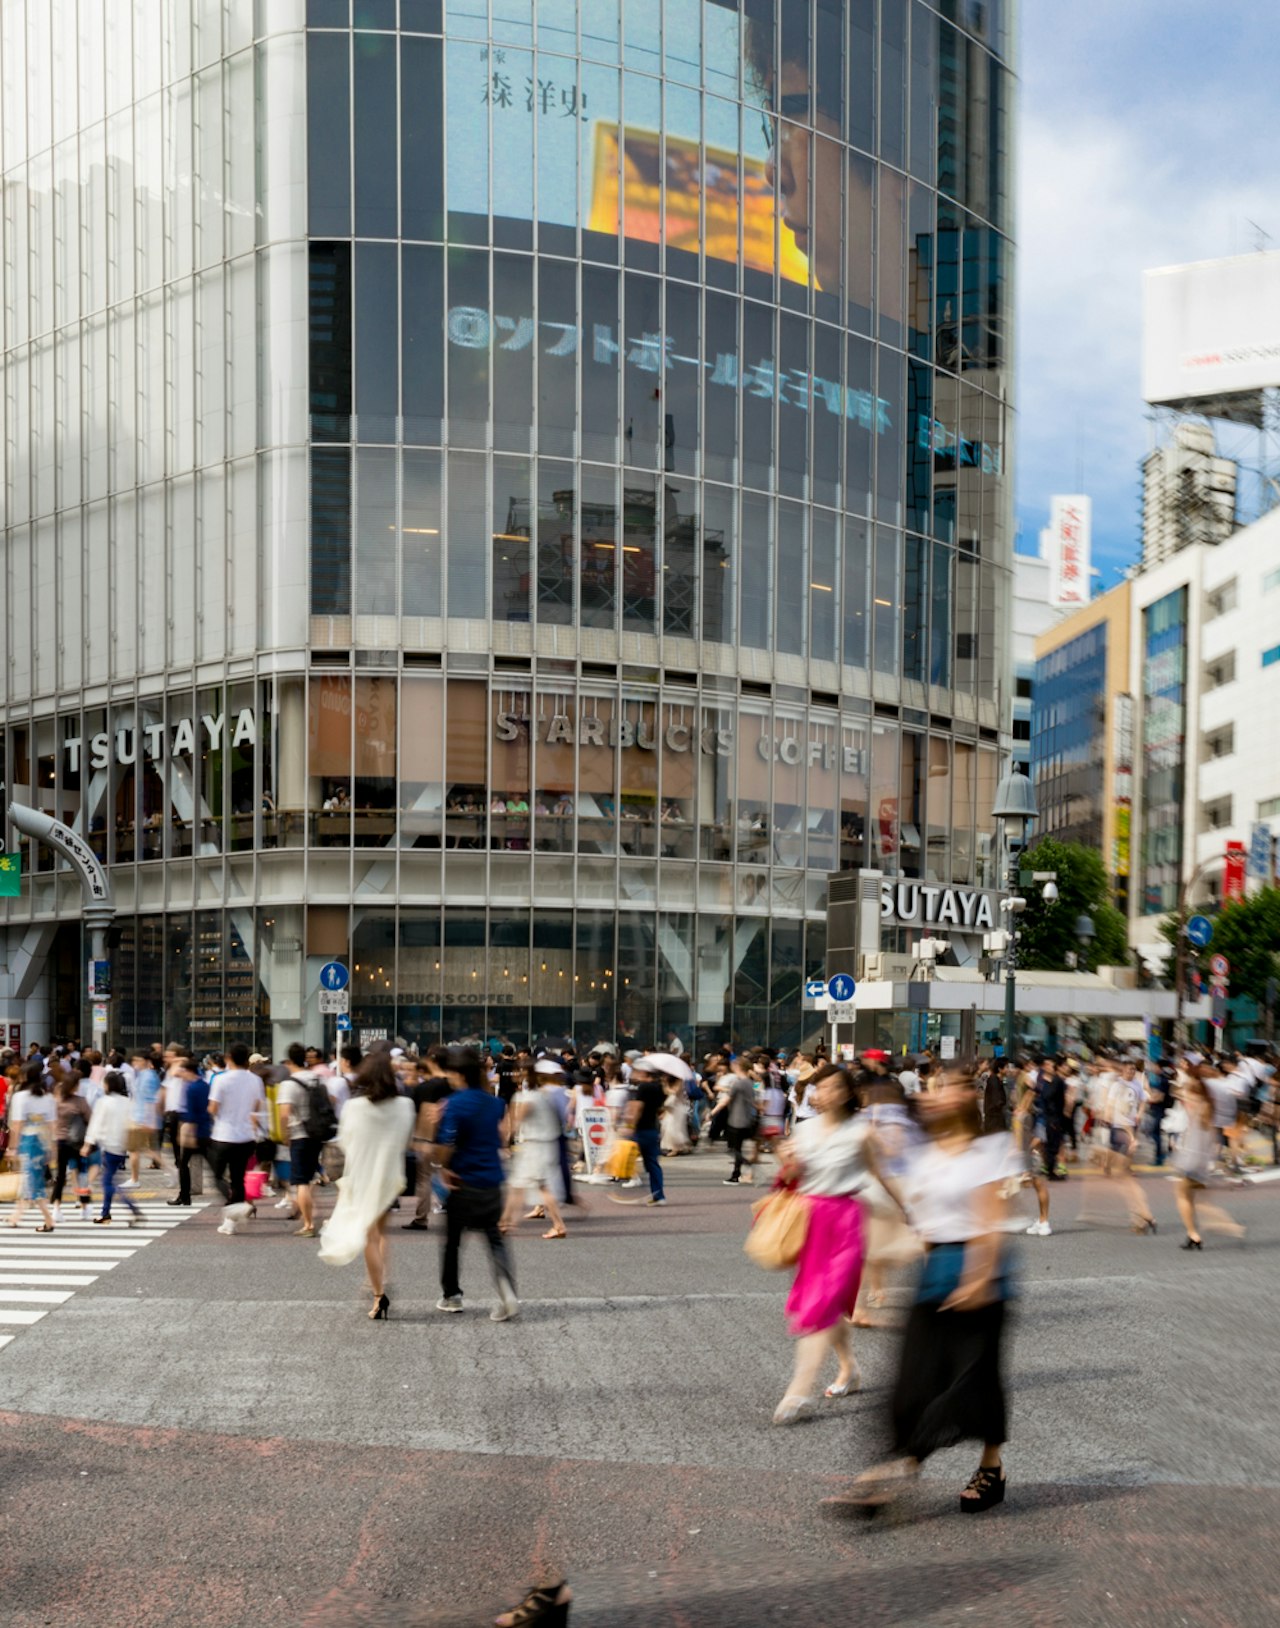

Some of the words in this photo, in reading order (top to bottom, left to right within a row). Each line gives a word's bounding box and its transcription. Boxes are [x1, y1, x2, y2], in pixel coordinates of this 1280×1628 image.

[480, 71, 513, 109] 森
[524, 76, 590, 122] 洋史
[64, 708, 256, 774] TSUTAYA
[496, 712, 735, 759] STARBUCKS
